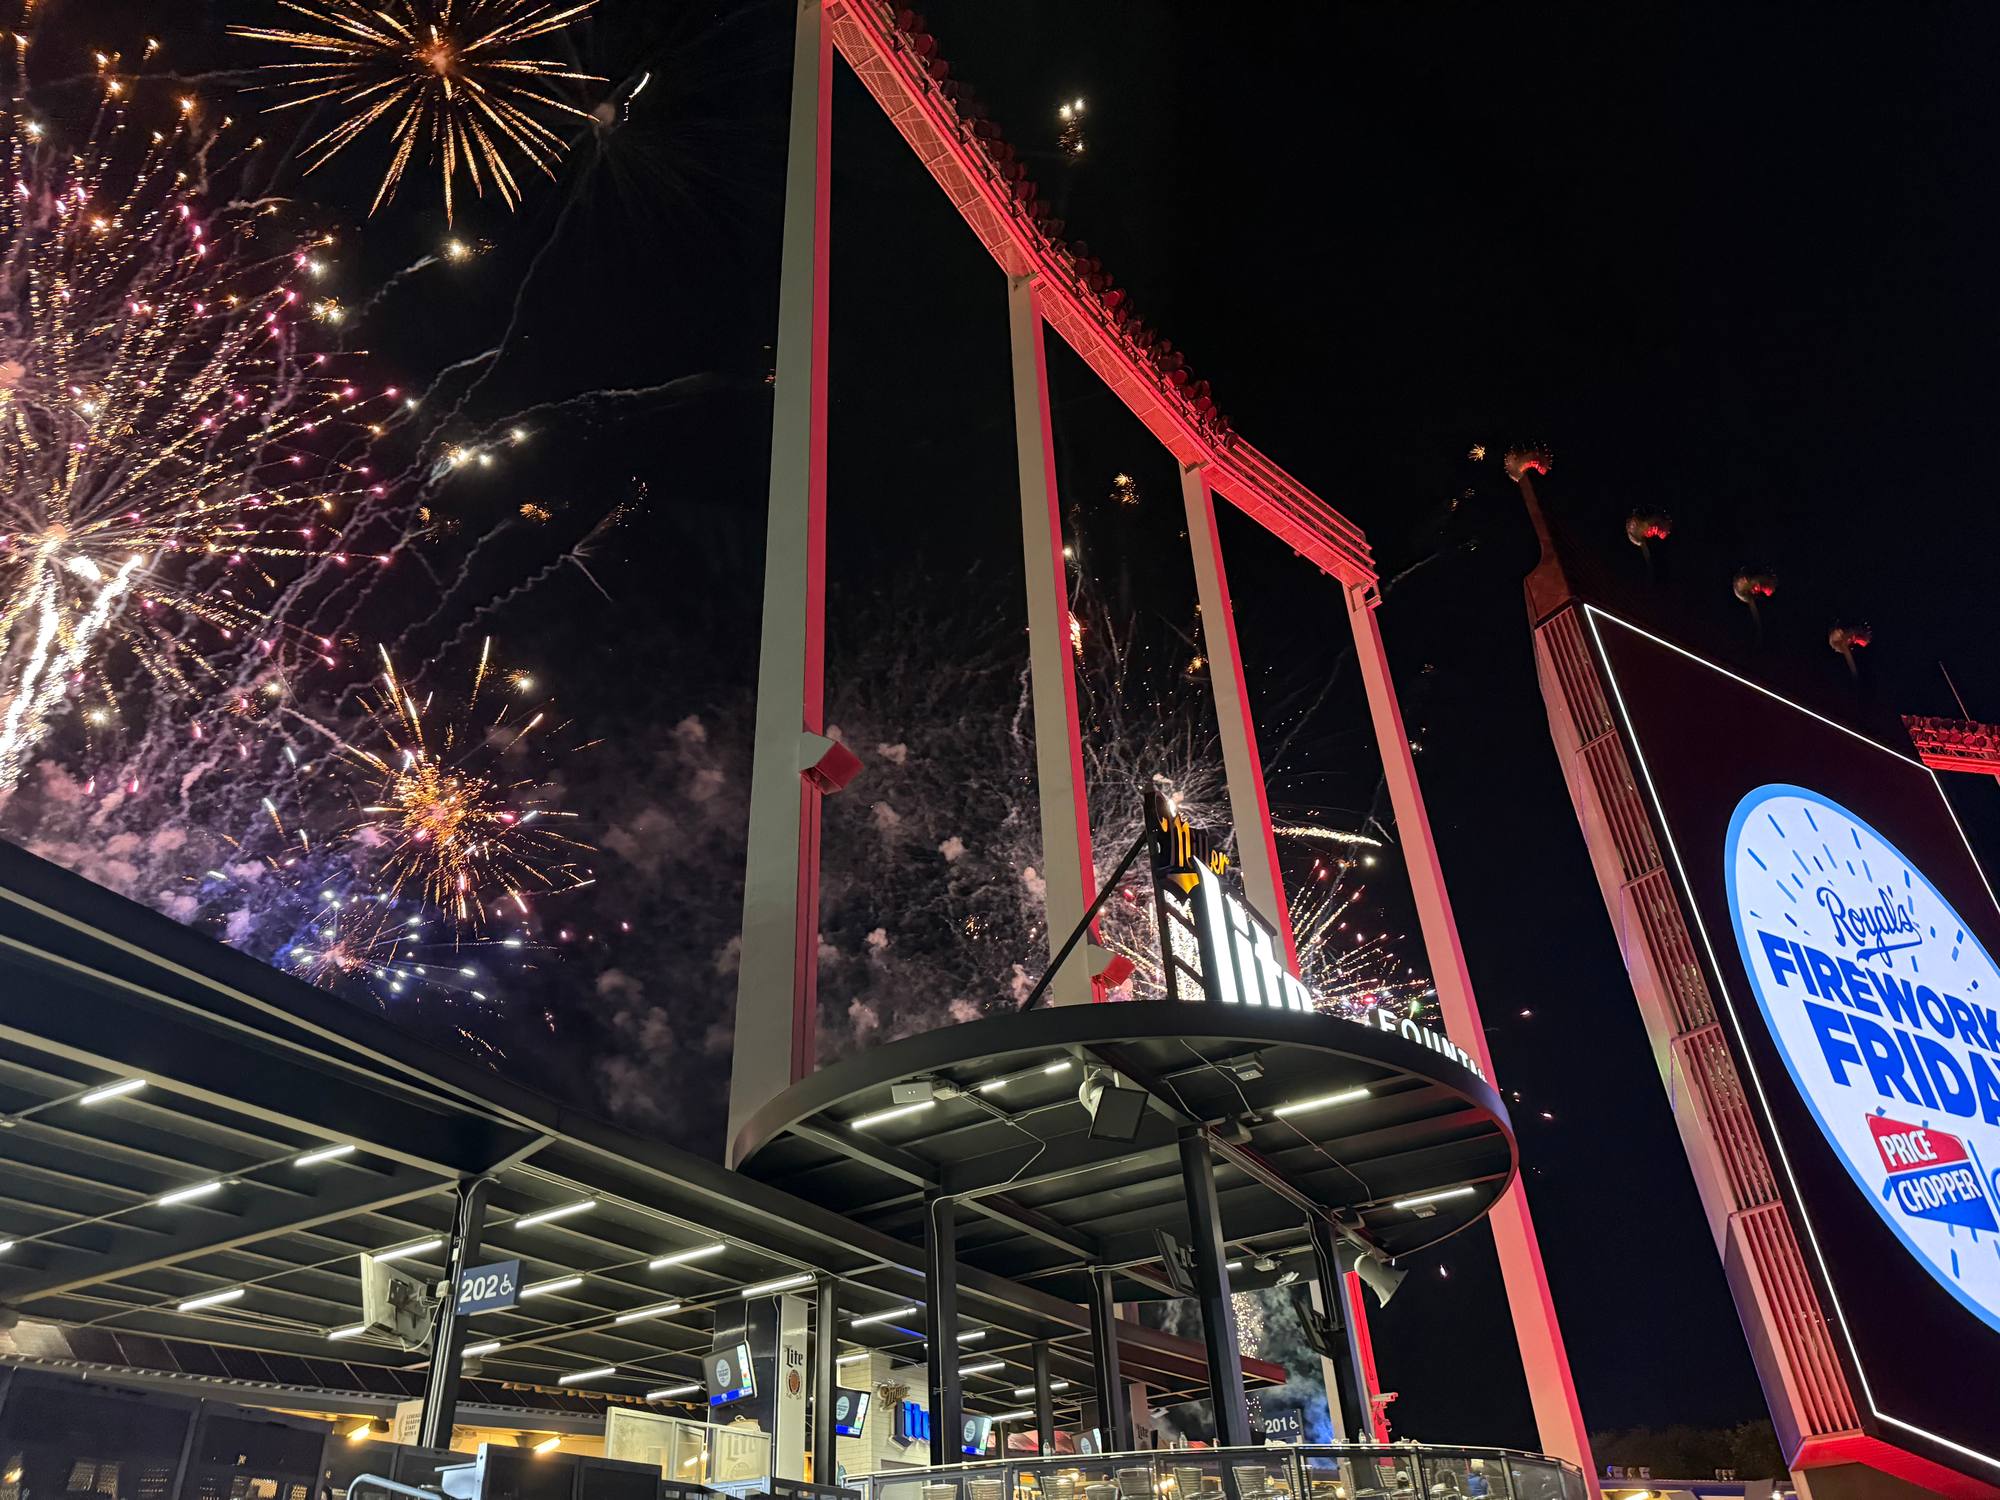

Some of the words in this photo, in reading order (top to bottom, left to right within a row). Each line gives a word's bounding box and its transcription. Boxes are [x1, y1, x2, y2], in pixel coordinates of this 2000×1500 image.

[1816, 886, 1922, 969] Royals
[1803, 999, 2000, 1126] FRIDA
[1879, 1129, 1938, 1167] PRICE
[1898, 1168, 1983, 1213] CHOPPER
[459, 1274, 499, 1303] 202
[783, 1345, 804, 1368] Lite
[1264, 1416, 1288, 1434] 201
